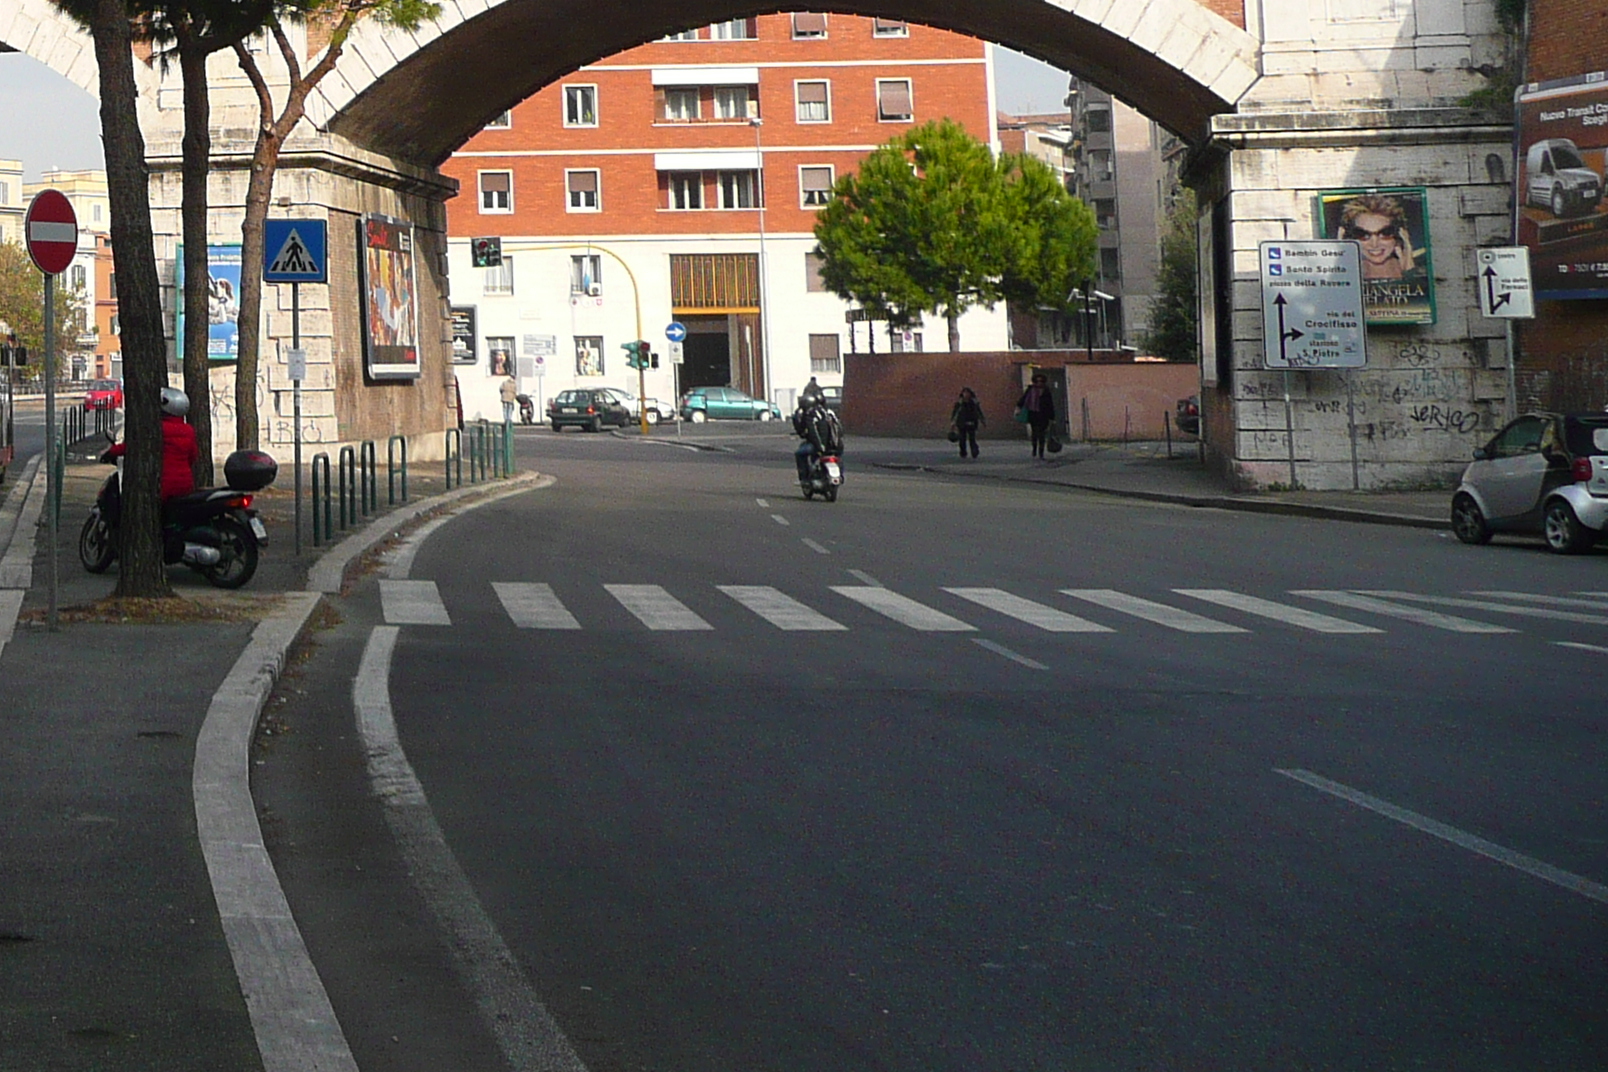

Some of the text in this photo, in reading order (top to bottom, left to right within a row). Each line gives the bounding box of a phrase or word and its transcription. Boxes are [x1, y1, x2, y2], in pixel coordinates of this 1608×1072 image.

[1540, 110, 1565, 122] Nuovo
[1567, 104, 1594, 117] Transit
[1285, 249, 1318, 257] Bambin
[1316, 266, 1347, 274] Spirito
[1294, 279, 1316, 287] della
[1320, 279, 1351, 287] Rovere
[1305, 319, 1357, 328] Crocifisso
[1312, 349, 1340, 357] Pietro
